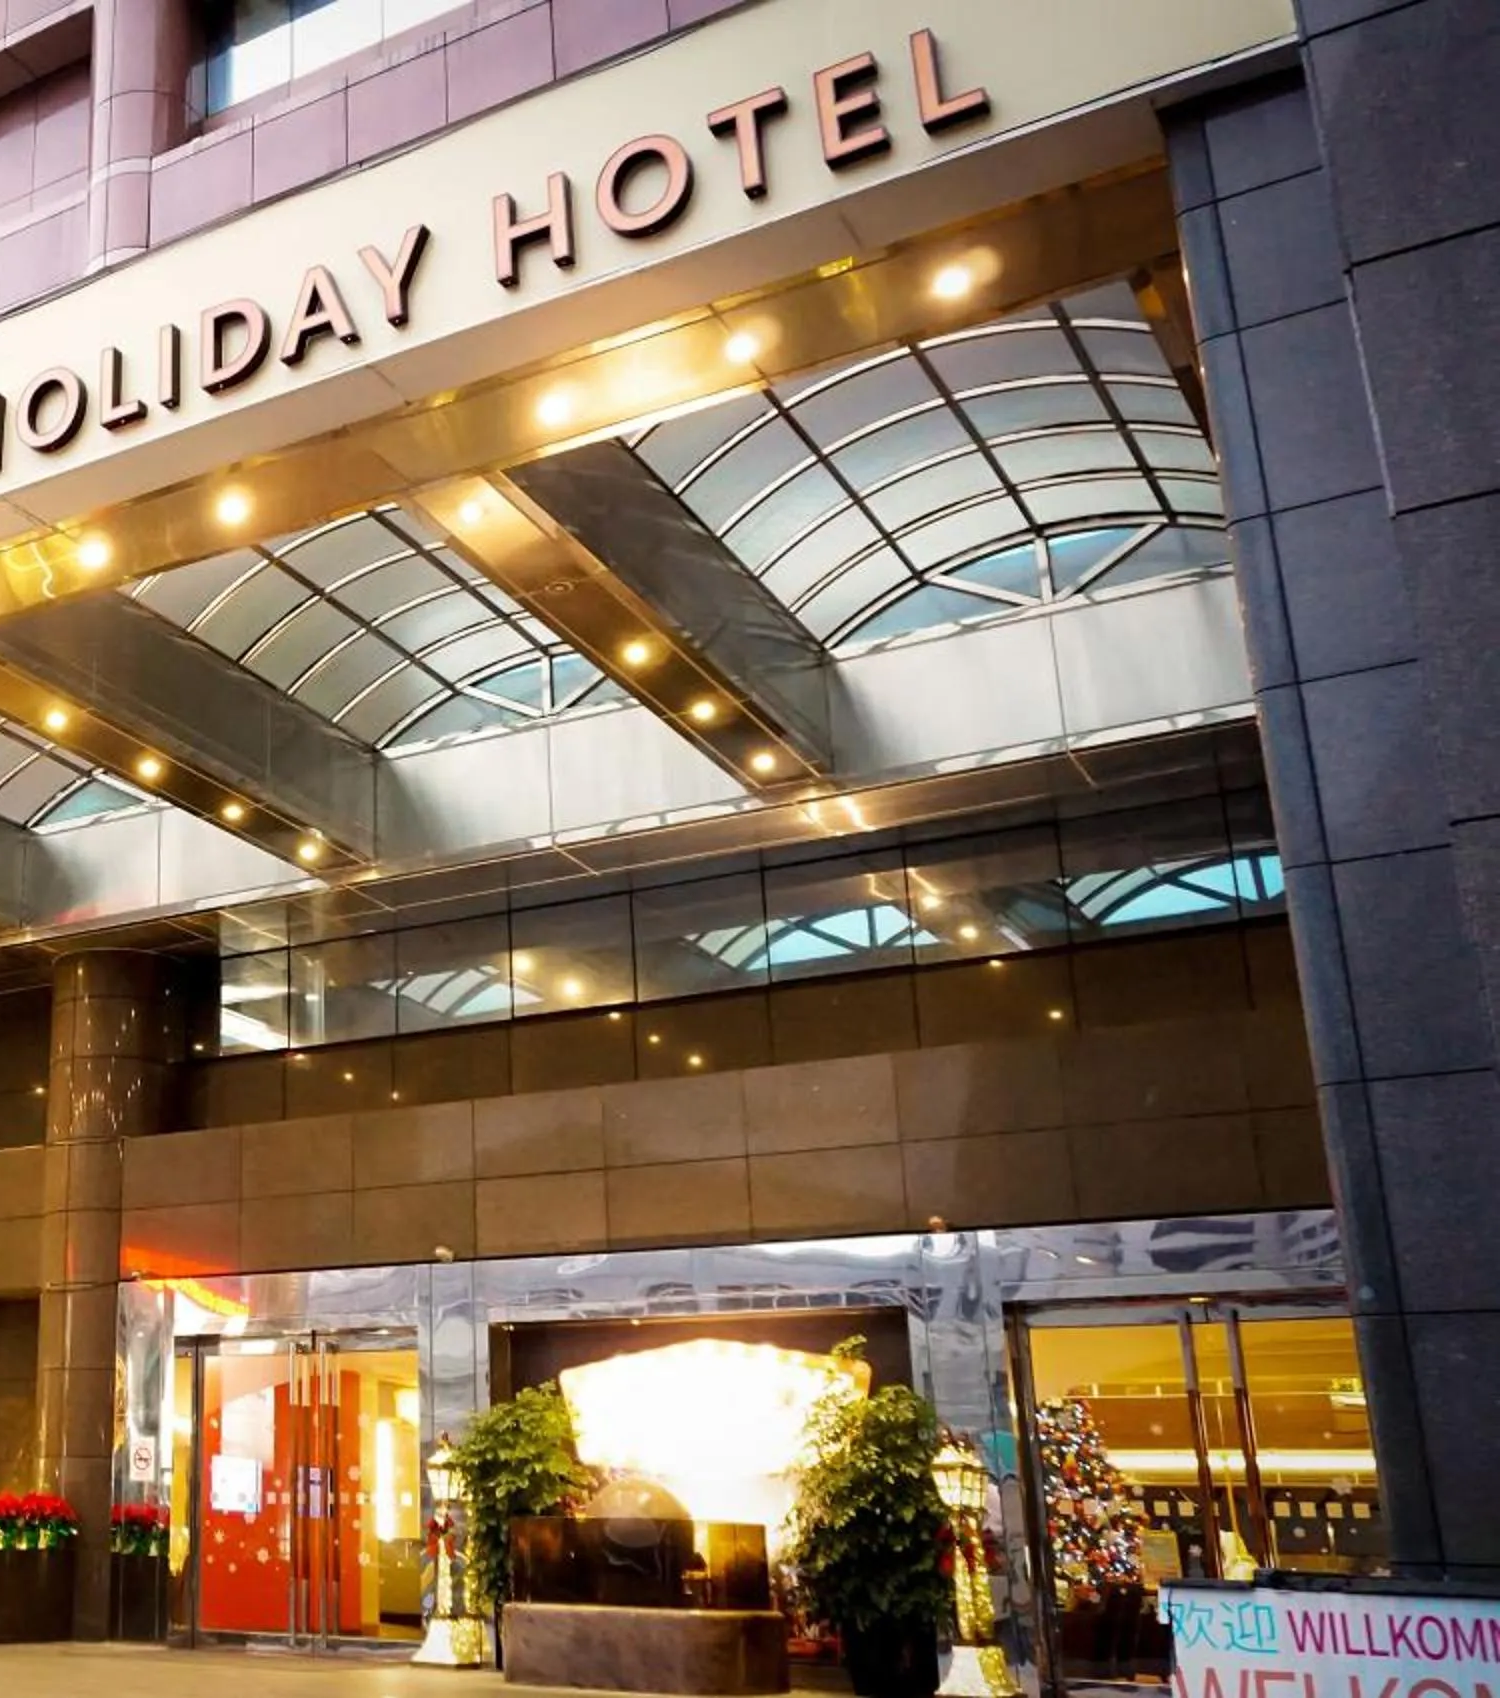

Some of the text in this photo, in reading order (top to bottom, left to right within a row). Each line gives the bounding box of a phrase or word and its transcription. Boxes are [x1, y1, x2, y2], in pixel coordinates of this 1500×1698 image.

[492, 28, 991, 288] HOTEL
[1163, 1600, 1500, 1663] 欢迎 WILLKOM
